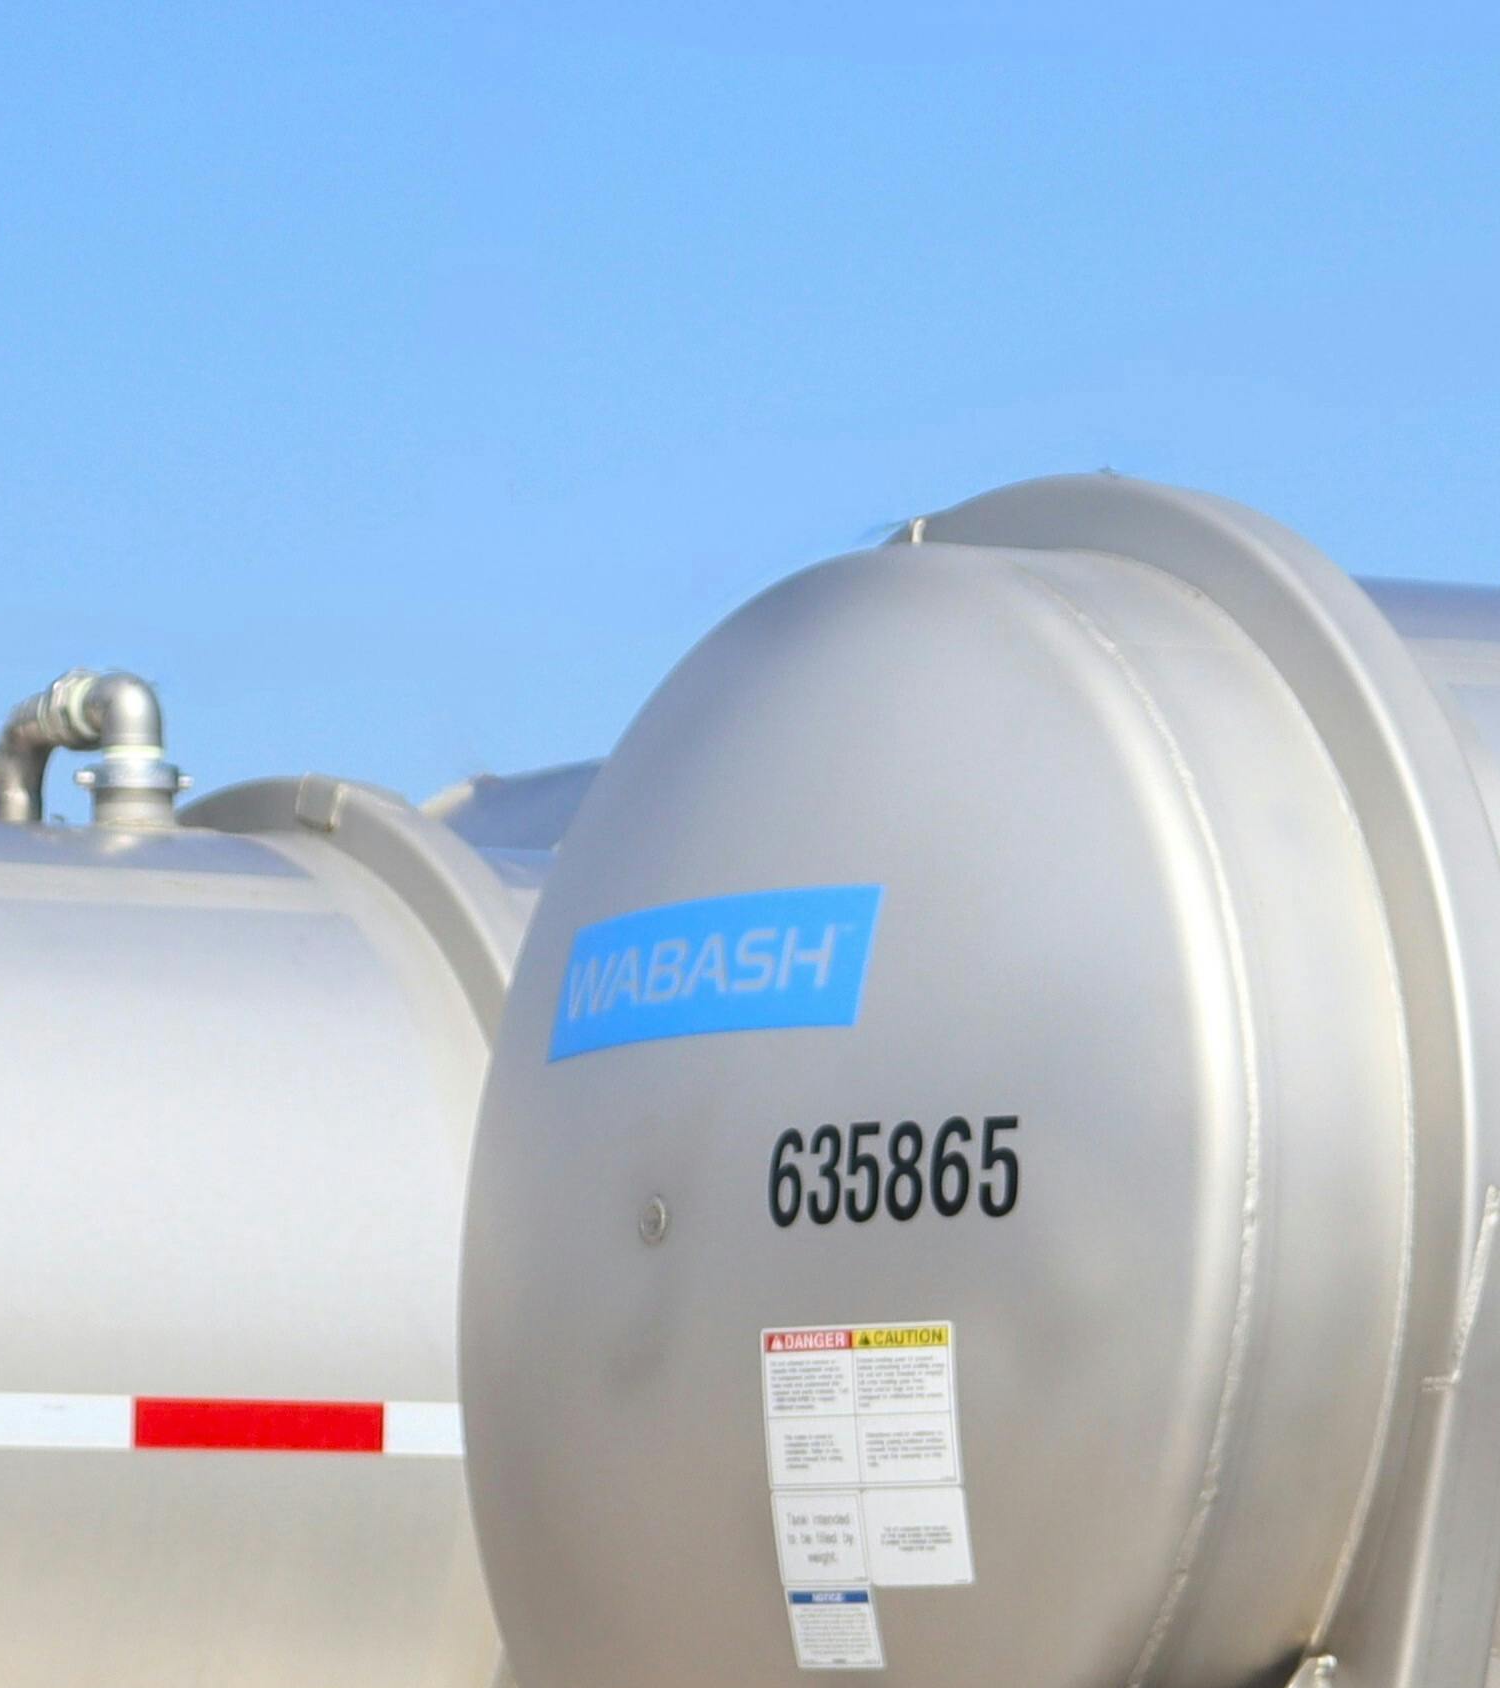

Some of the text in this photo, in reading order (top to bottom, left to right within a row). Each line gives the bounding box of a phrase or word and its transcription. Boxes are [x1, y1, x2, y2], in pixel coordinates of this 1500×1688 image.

[567, 923, 837, 1021] WABASH
[768, 1115, 1019, 1228] 635865
[784, 1332, 845, 1349] DANGER
[873, 1327, 943, 1345] CAUTION
